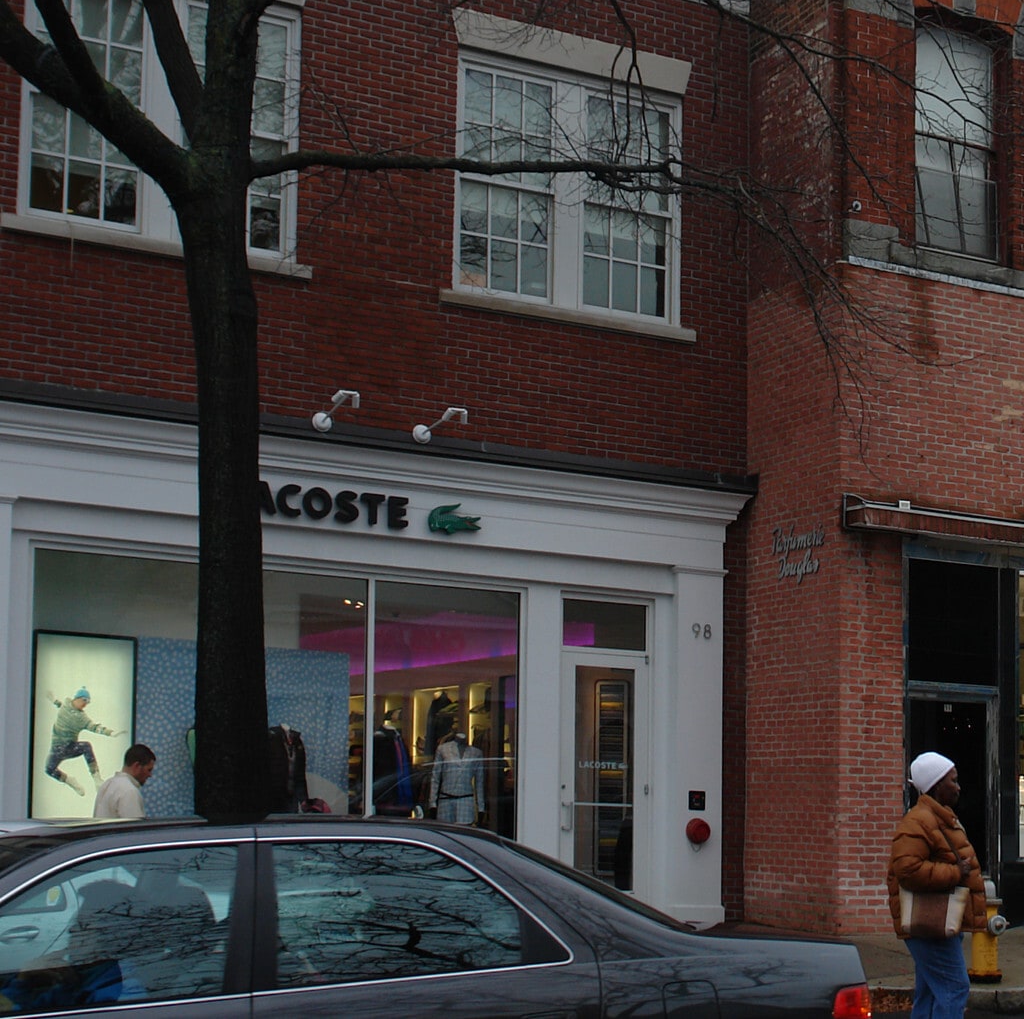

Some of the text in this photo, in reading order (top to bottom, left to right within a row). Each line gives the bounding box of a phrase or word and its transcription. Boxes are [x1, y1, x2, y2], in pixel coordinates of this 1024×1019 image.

[259, 481, 409, 530] ACOSTE
[778, 548, 820, 584] Douglas
[692, 623, 712, 639] 98
[578, 760, 617, 770] LACOSTE
